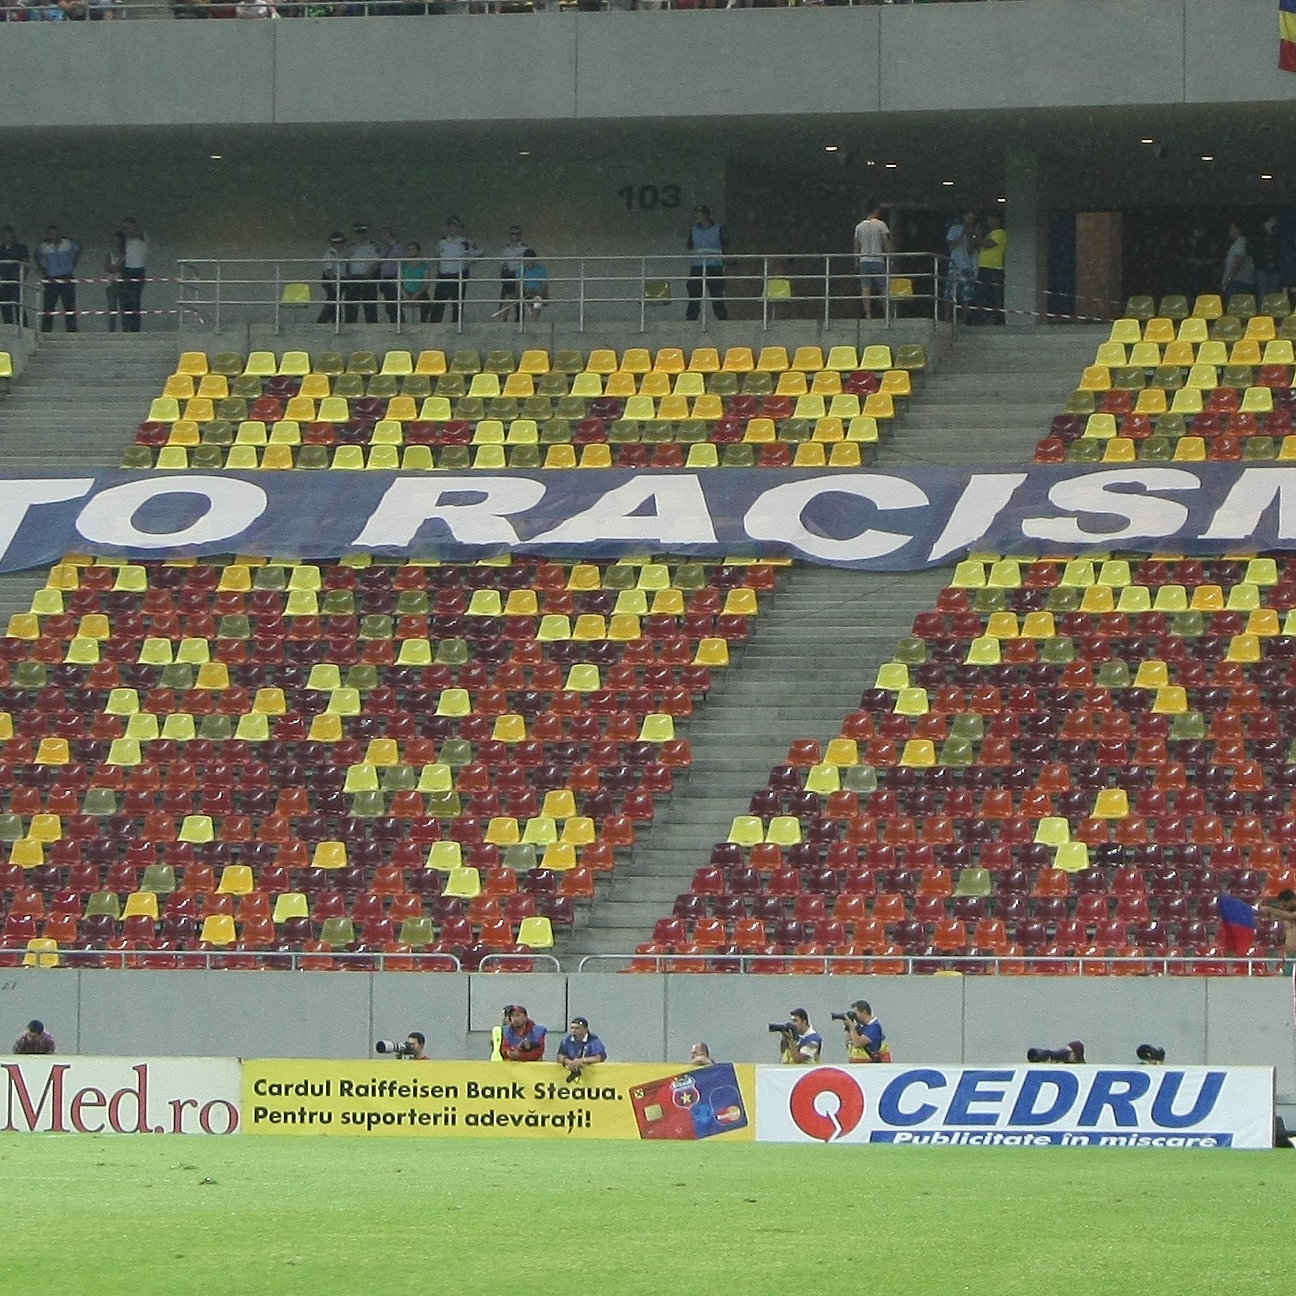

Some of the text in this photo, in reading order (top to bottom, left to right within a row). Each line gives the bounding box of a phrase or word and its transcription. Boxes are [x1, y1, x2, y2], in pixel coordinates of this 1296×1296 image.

[618, 184, 680, 210] 103
[253, 1078, 623, 1101] Cardul Raiffeisen Bank Steaua.
[878, 1069, 1228, 1128] CEDRU
[253, 1106, 333, 1125] Pentru
[340, 1106, 457, 1131] suporterii
[893, 1131, 1052, 1146] Publicitate
